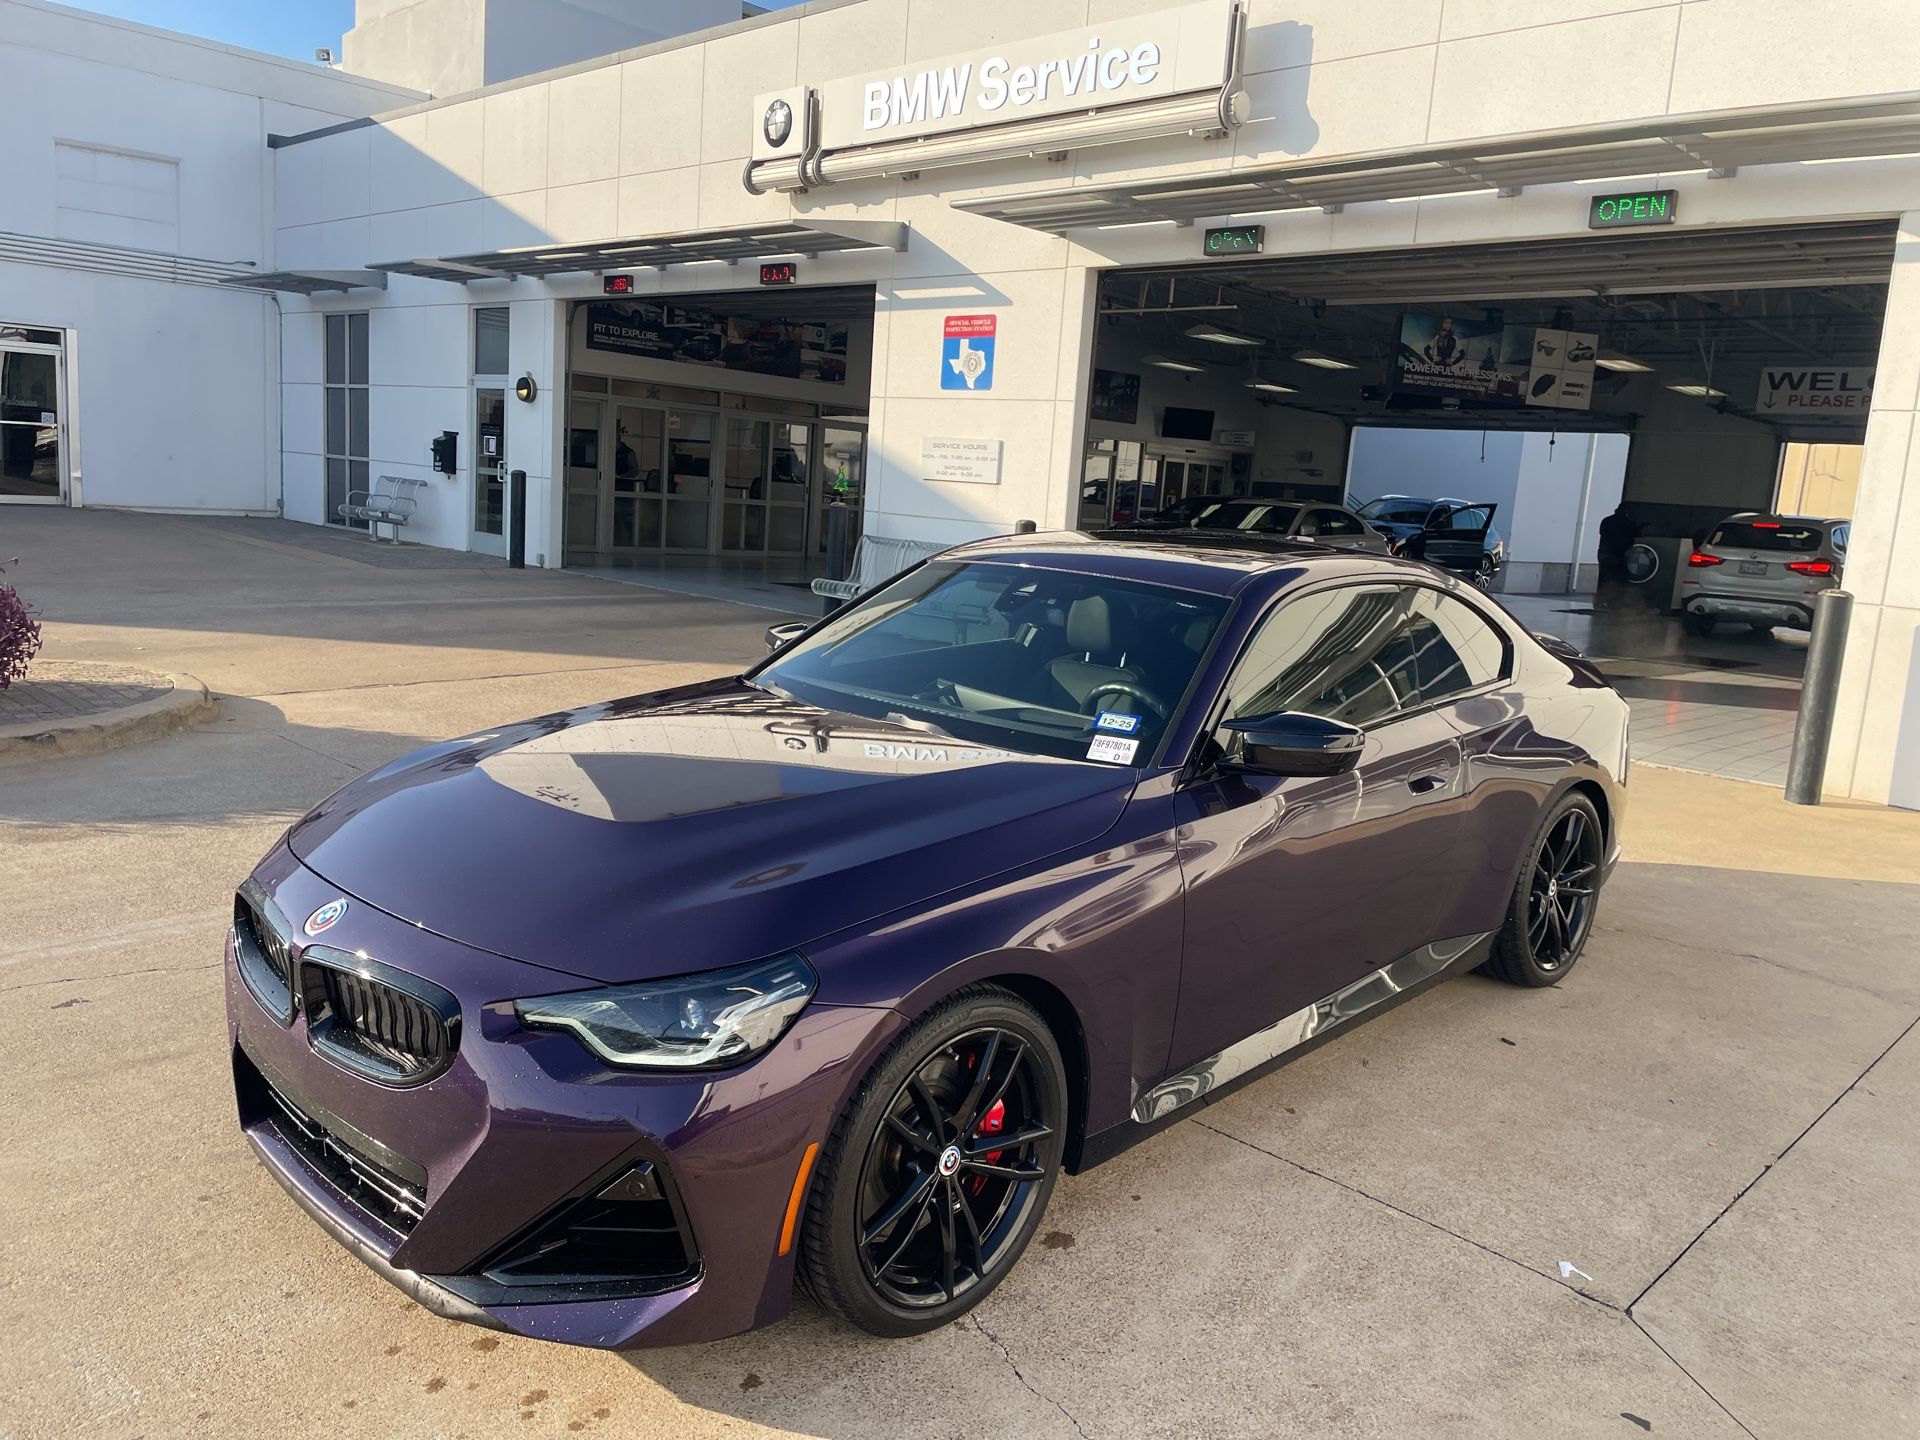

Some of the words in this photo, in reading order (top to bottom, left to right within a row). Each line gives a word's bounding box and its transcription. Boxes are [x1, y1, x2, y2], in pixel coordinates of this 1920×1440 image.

[864, 63, 971, 131] BMW
[978, 38, 1160, 111] Service
[1598, 195, 1667, 220] OPEN
[593, 323, 606, 333] FIT
[608, 325, 620, 335] TO
[622, 327, 660, 341] EXPLORE
[1404, 362, 1453, 376] POWERFUL
[1787, 395, 1856, 408] PLEASE
